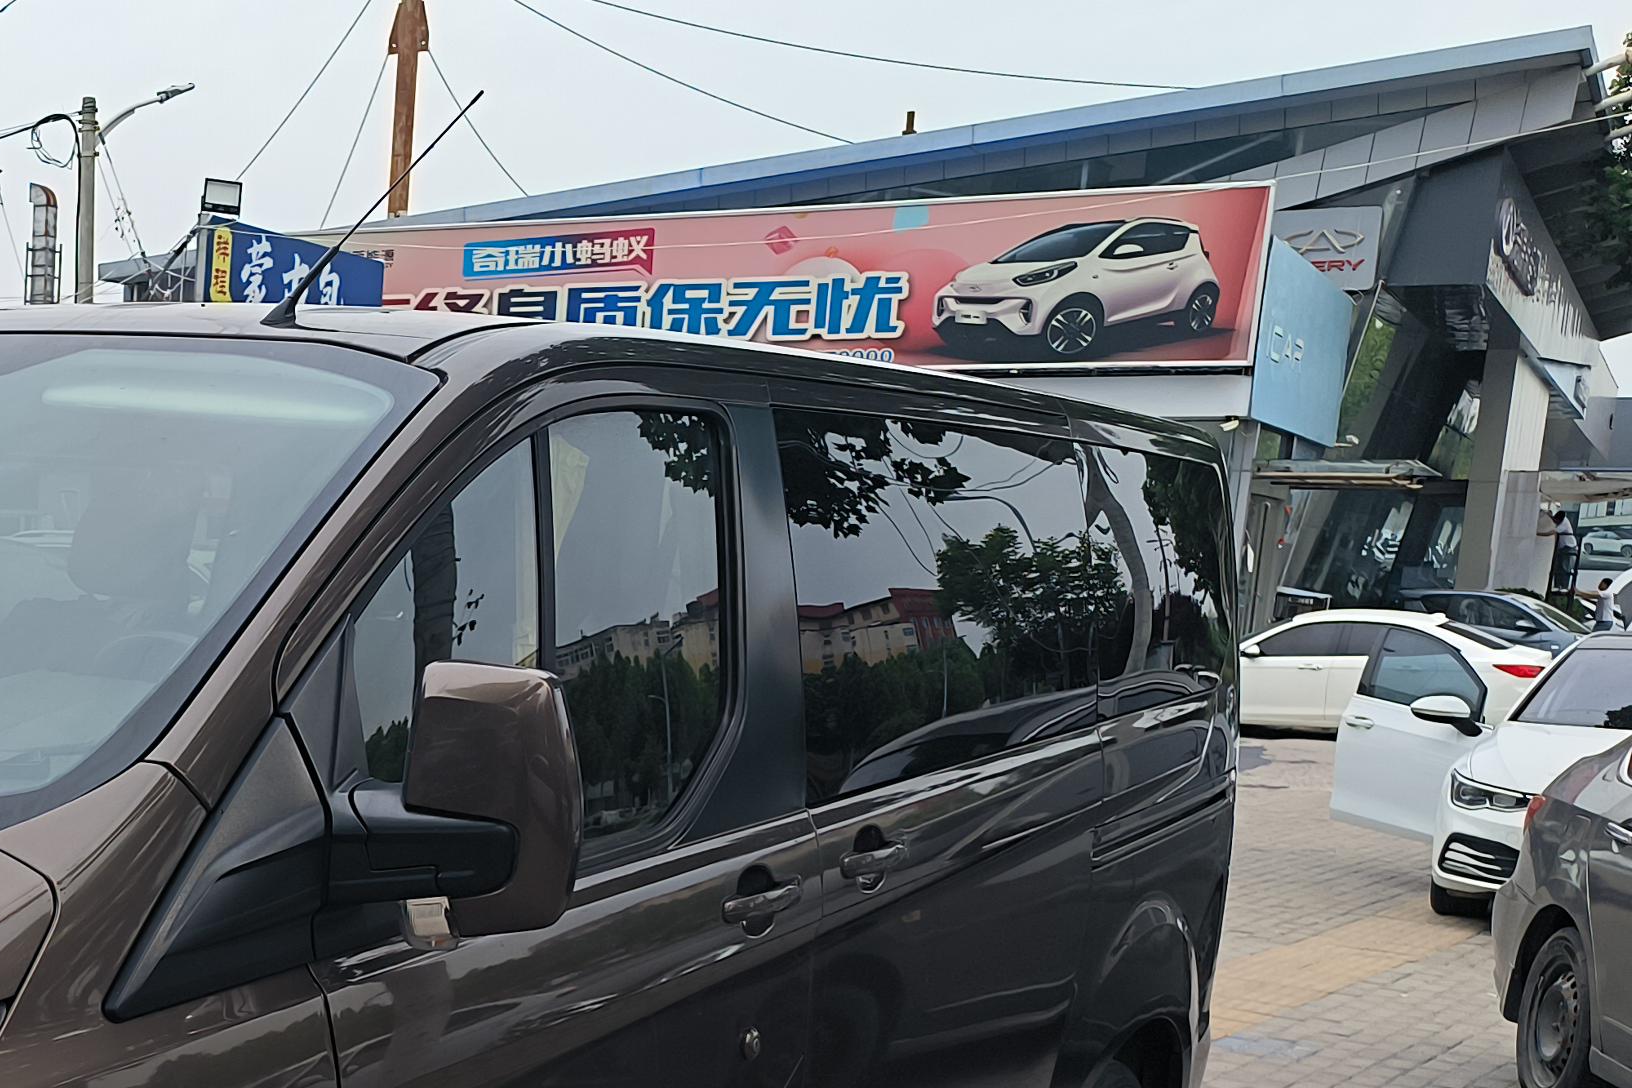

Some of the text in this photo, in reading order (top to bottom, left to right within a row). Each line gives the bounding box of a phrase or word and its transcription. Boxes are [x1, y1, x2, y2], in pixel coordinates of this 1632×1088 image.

[472, 234, 649, 273] 奇瑞小蚂蚁
[1311, 258, 1366, 273] ERY
